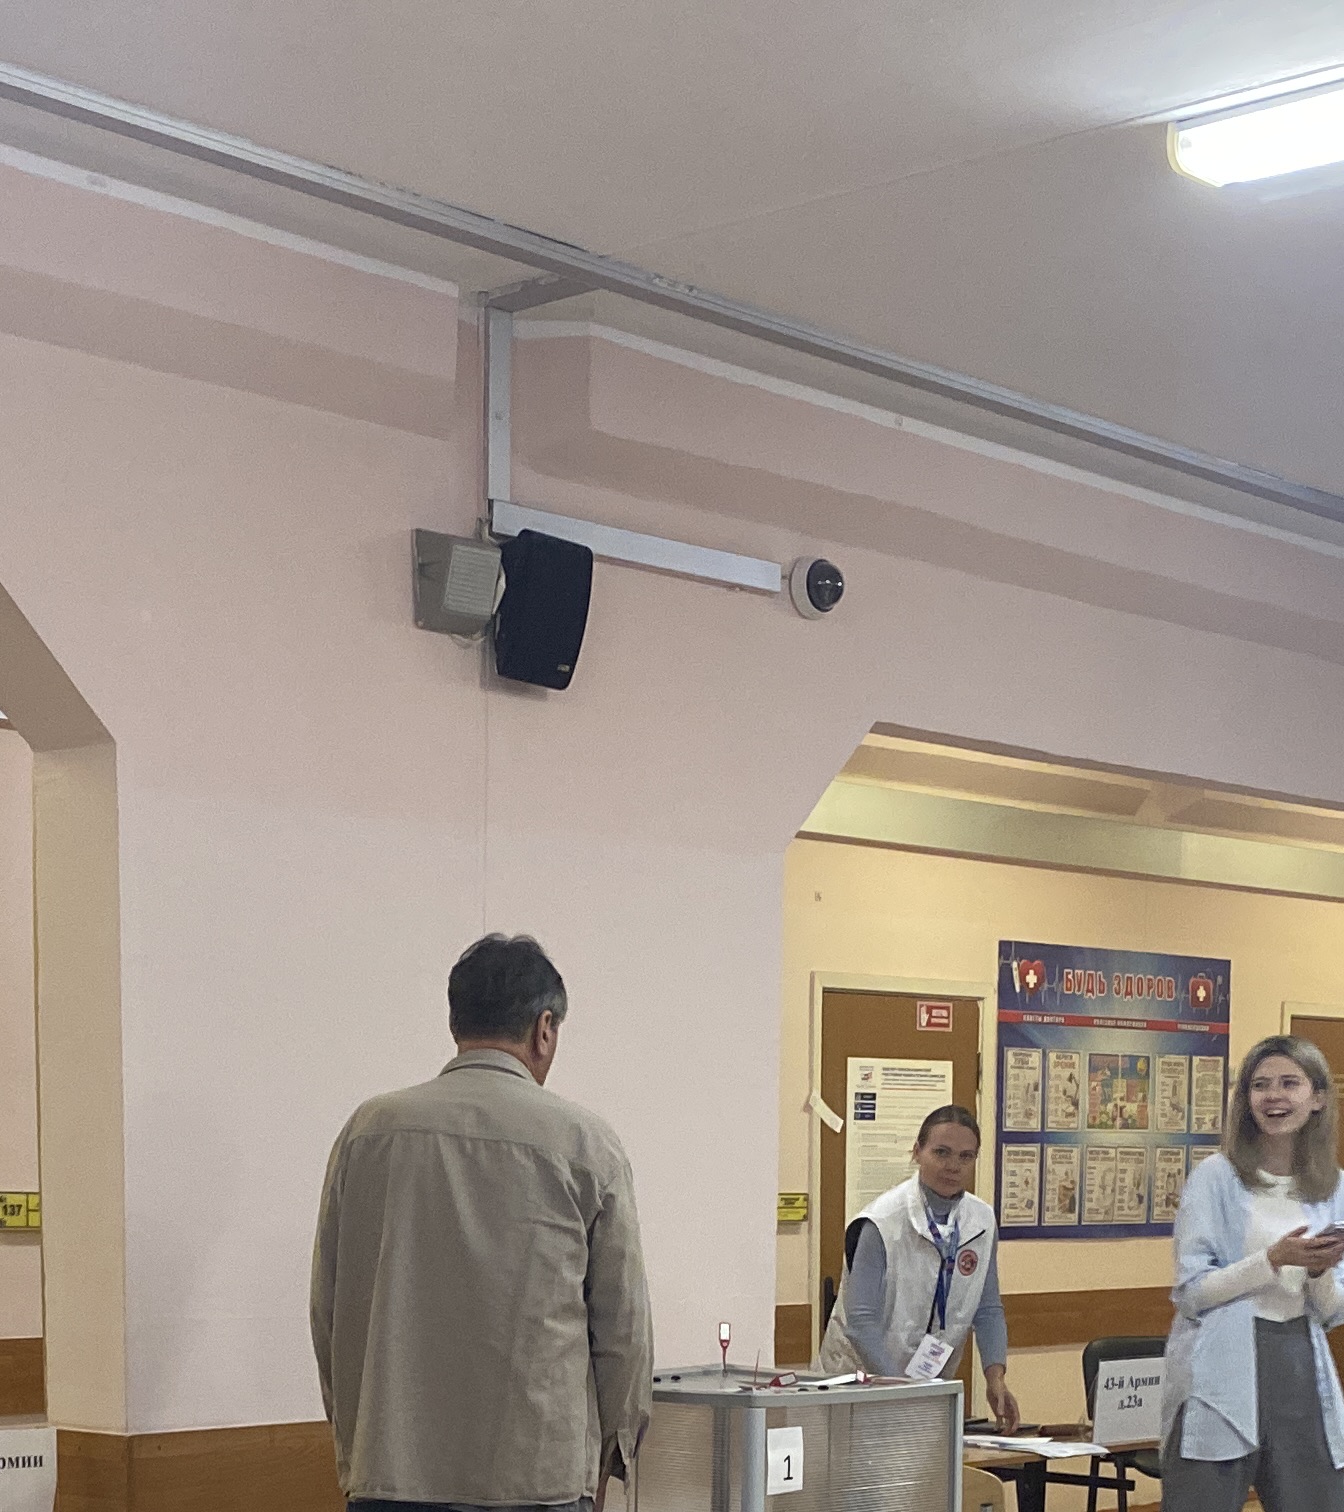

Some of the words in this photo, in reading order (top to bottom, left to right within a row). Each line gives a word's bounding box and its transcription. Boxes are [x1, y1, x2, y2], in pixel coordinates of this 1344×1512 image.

[1063, 968, 1106, 999] БУДЬ
[1113, 973, 1176, 1001] ЗДОРОВ
[2, 1204, 23, 1216] 137
[1104, 1376, 1125, 1390] 43-й
[1127, 1375, 1161, 1391] Армии
[783, 1454, 794, 1481] 1
